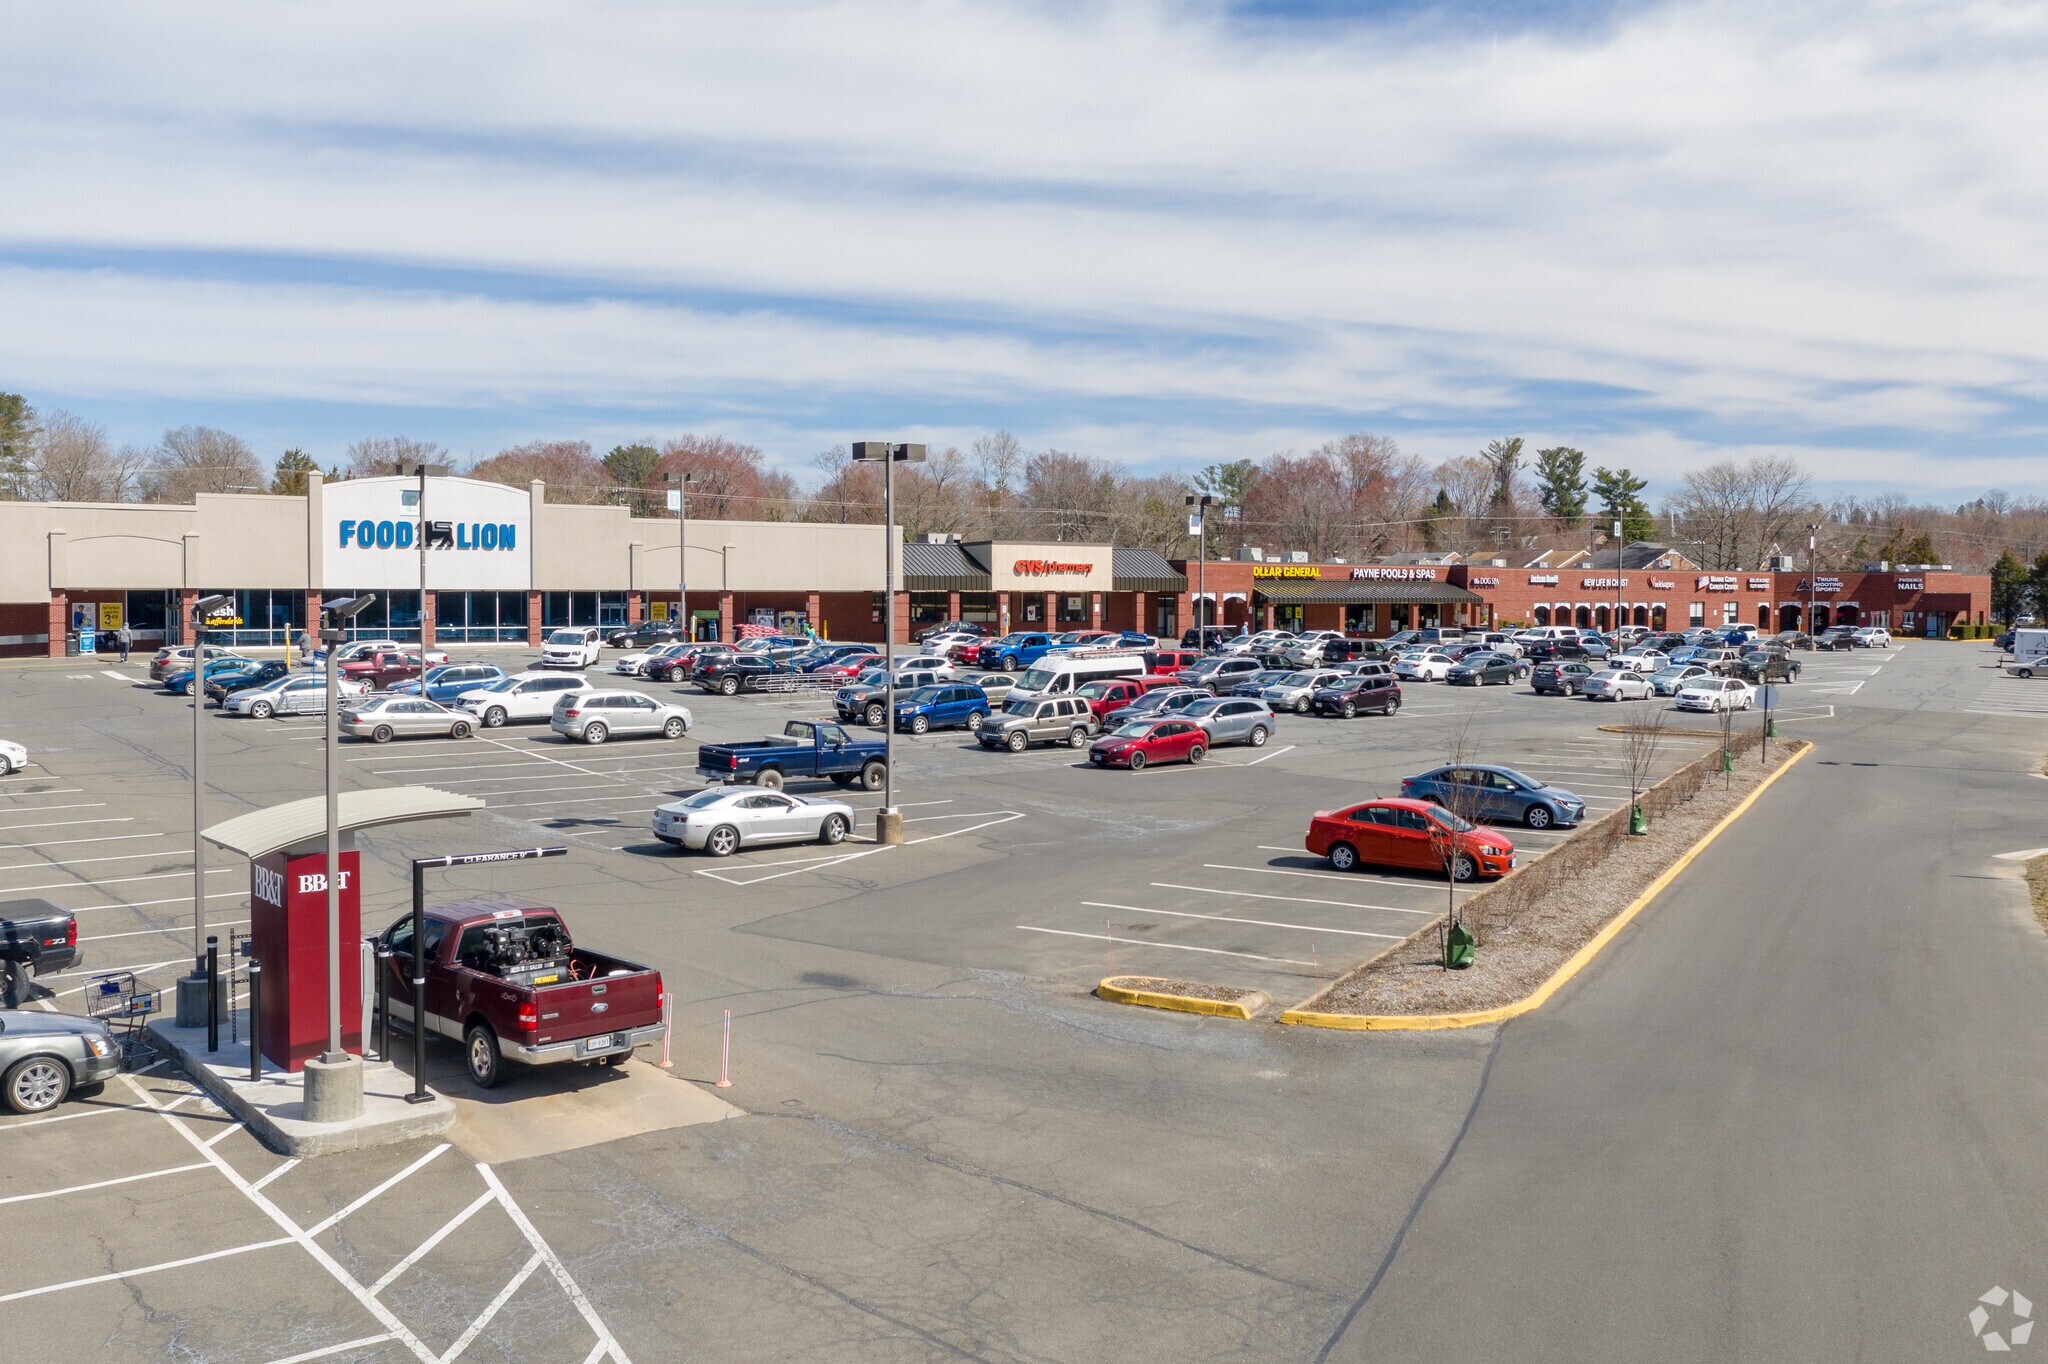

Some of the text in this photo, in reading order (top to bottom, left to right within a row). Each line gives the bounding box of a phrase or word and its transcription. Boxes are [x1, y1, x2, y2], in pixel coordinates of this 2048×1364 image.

[341, 520, 516, 549] FOOD LION
[1253, 566, 1322, 577] OLLAR GENERAL
[1354, 568, 1436, 579] PAYNE POOLS & SPAS
[1583, 578, 1595, 587] NEW
[1595, 578, 1606, 587] LIFE
[1606, 578, 1612, 587] IN
[463, 852, 518, 864] CLEARANCE
[254, 864, 284, 908] BB&T
[43, 937, 66, 946] Z71
